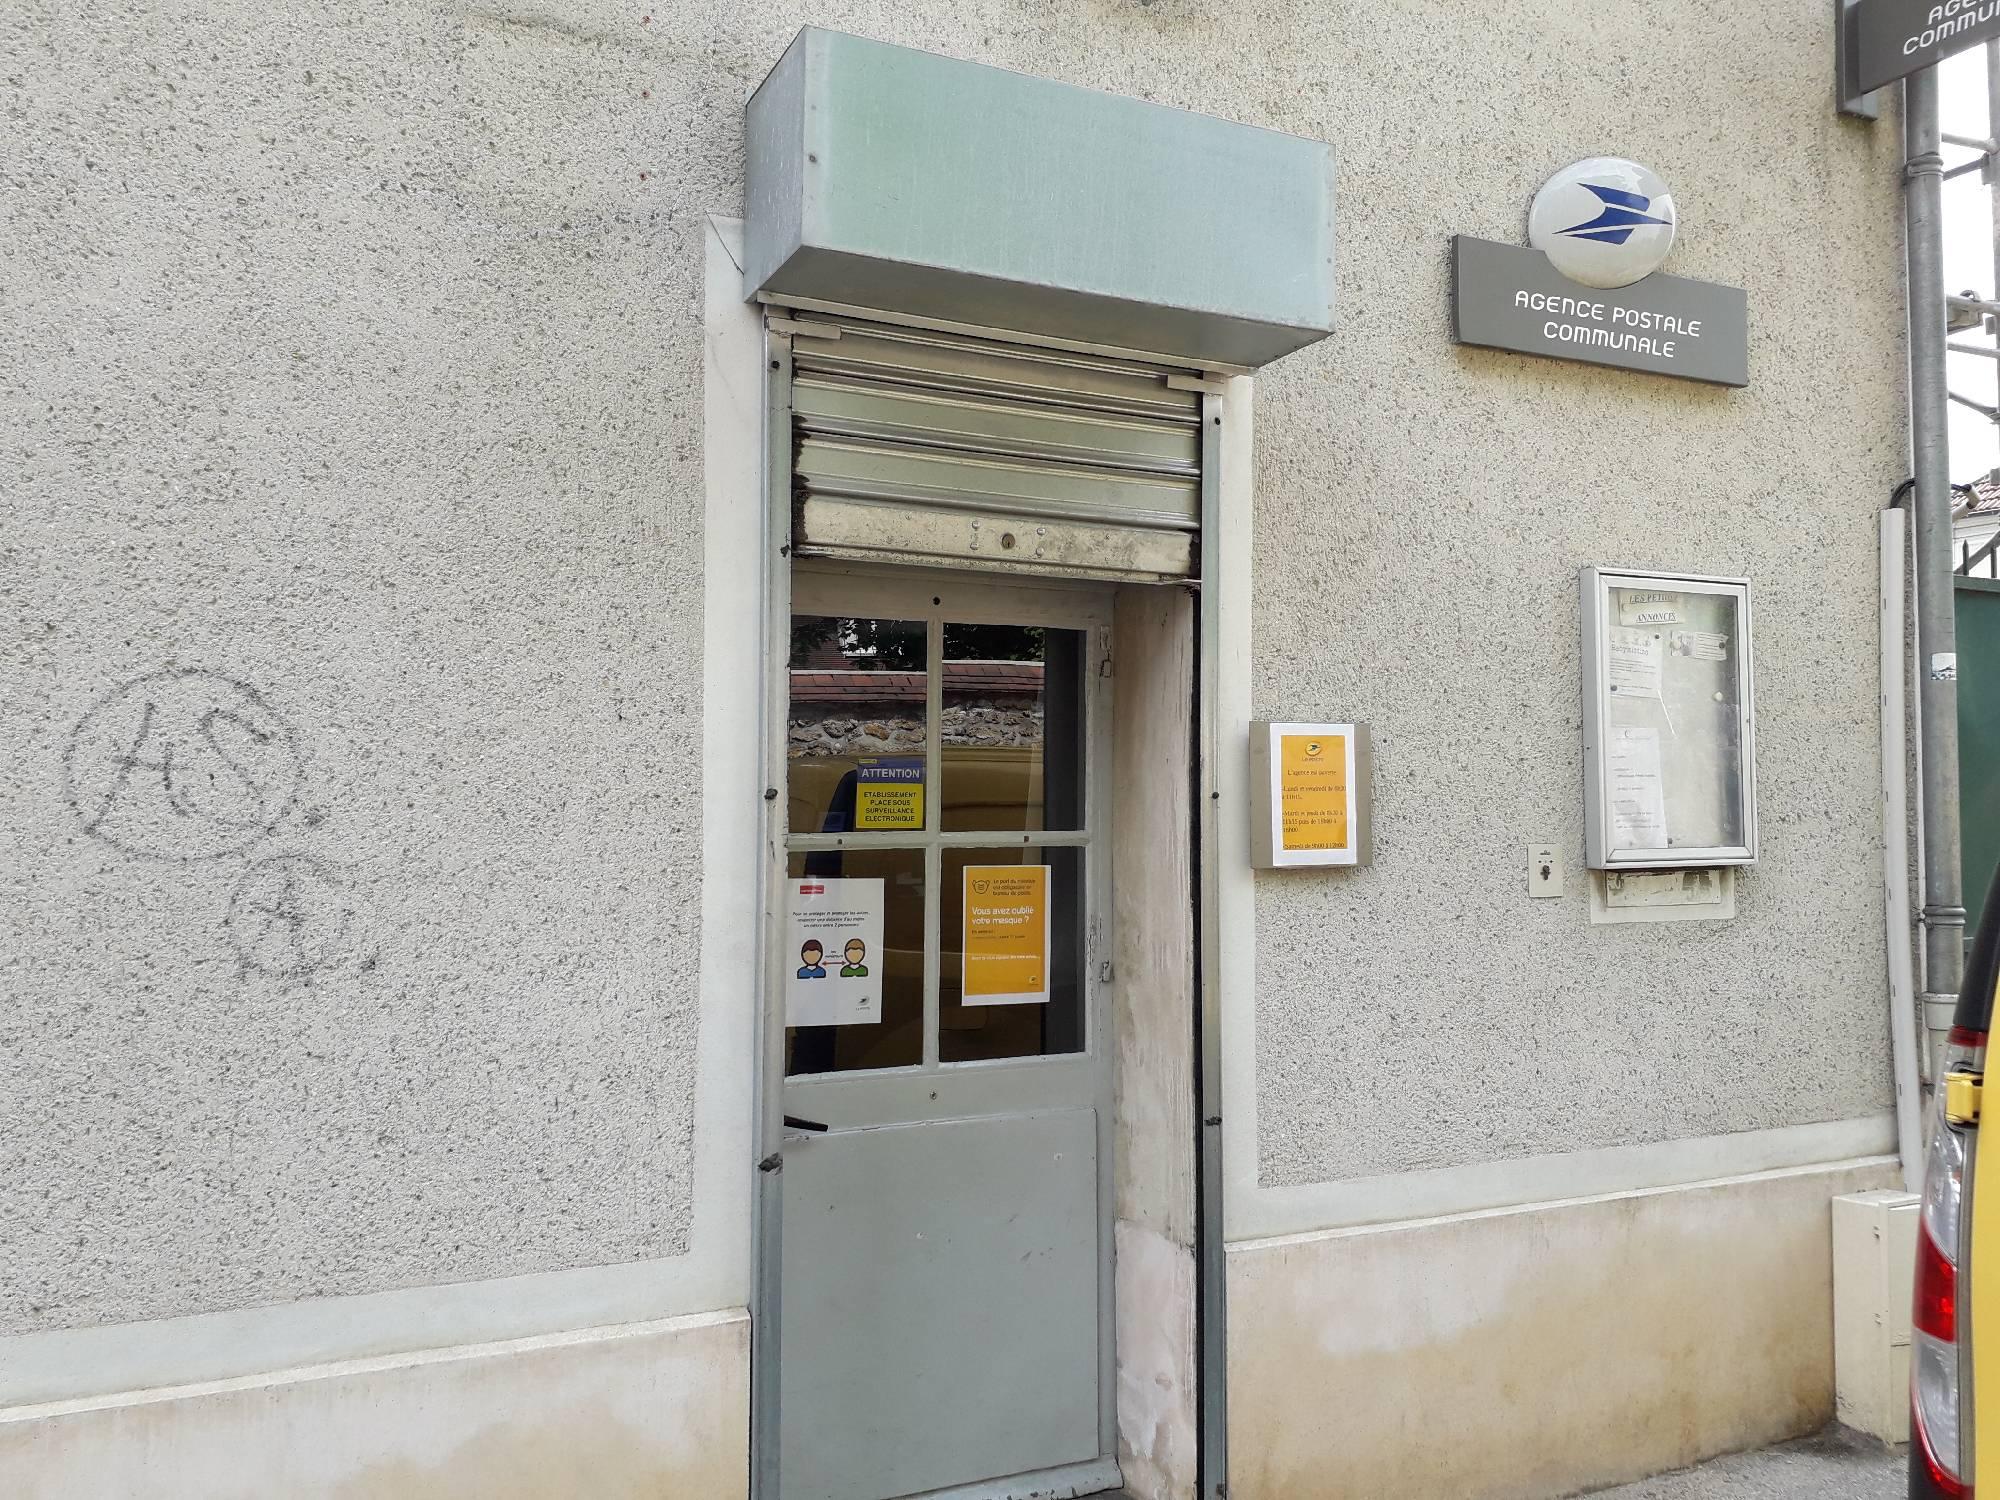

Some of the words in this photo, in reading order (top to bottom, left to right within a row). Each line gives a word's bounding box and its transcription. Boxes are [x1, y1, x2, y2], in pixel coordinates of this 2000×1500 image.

[1928, 0, 1983, 25] AGE
[1515, 290, 1605, 321] AGENCE
[1612, 307, 1702, 338] POSTALE
[1543, 321, 1676, 358] COMMUNALE
[1630, 595, 1647, 603] LES
[861, 768, 920, 778] ATTENTION
[972, 906, 991, 915] Vous
[1011, 905, 1034, 915] oublié
[972, 917, 991, 925] votre
[992, 917, 1023, 926] masque
[1024, 915, 1029, 924] ?
